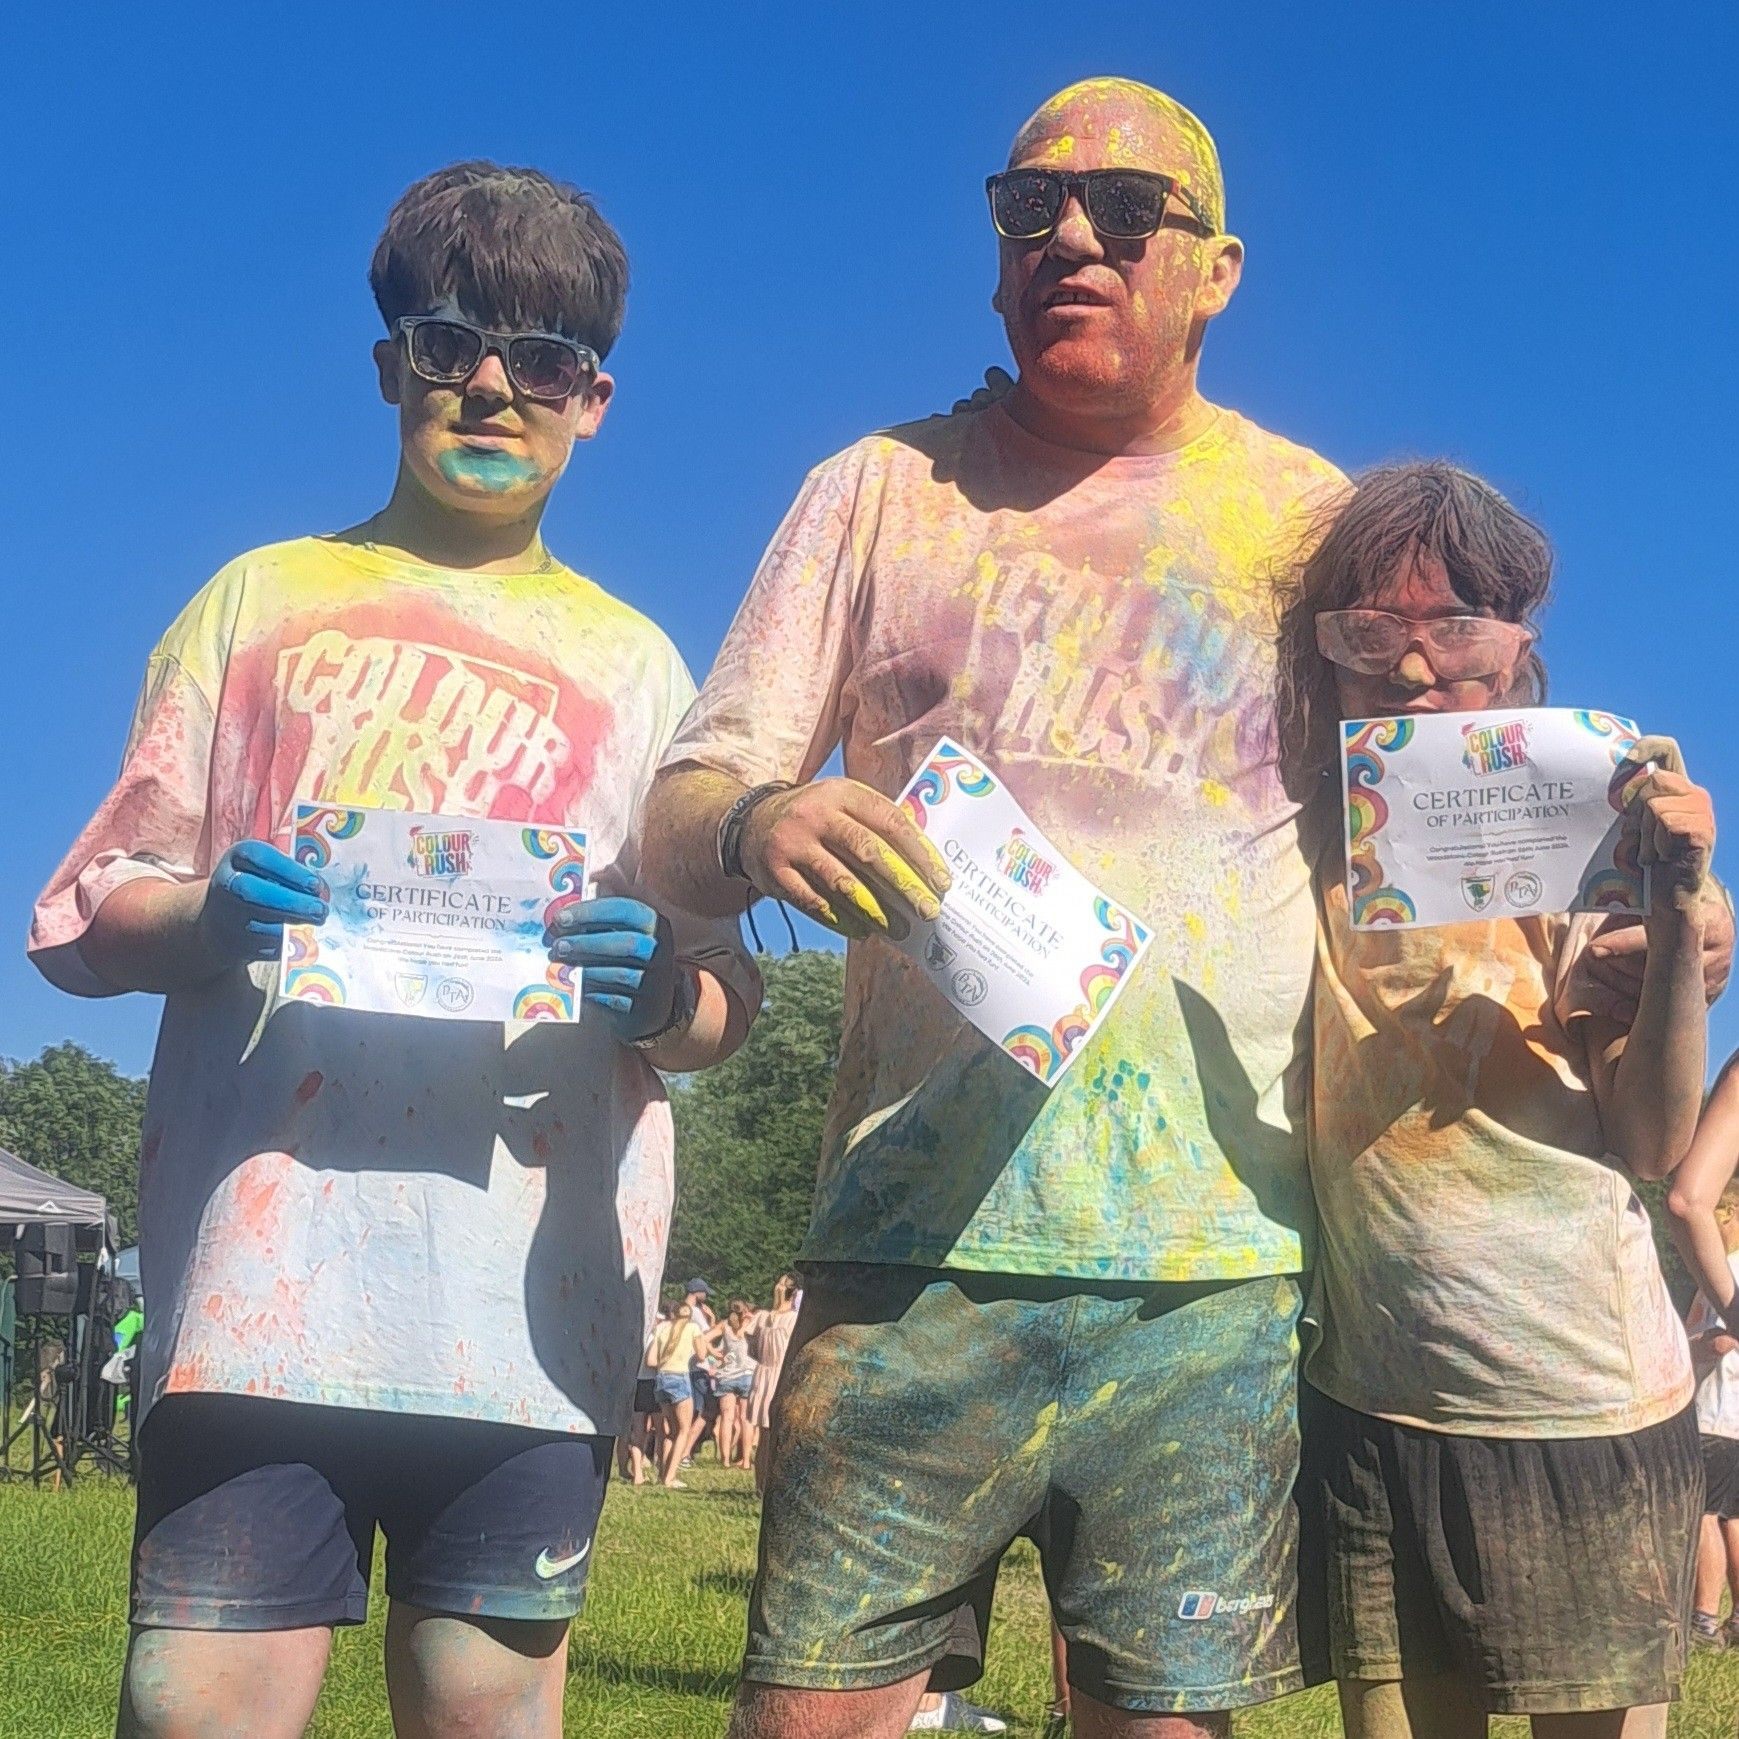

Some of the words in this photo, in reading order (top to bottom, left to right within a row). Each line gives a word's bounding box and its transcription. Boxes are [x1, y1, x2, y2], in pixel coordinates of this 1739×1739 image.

[286, 629, 571, 806] COLOUR
[1469, 723, 1526, 753] COLOUR
[1479, 743, 1525, 774] RUSH
[1413, 782, 1574, 810] CERTIFICATE
[1426, 814, 1448, 828] OF
[1452, 803, 1569, 827] PARTICIPATION
[415, 832, 470, 855] COLOUR
[1007, 839, 1053, 878] COLOUR
[424, 852, 467, 876] RUSH
[1003, 858, 1042, 894] RUSH
[354, 883, 512, 914] CERTIFICATE
[944, 839, 1064, 949] CERTIFICATE
[366, 906, 387, 920] OF
[392, 908, 506, 931] PARTICIPATION
[958, 880, 1051, 958] PARTICIPATION
